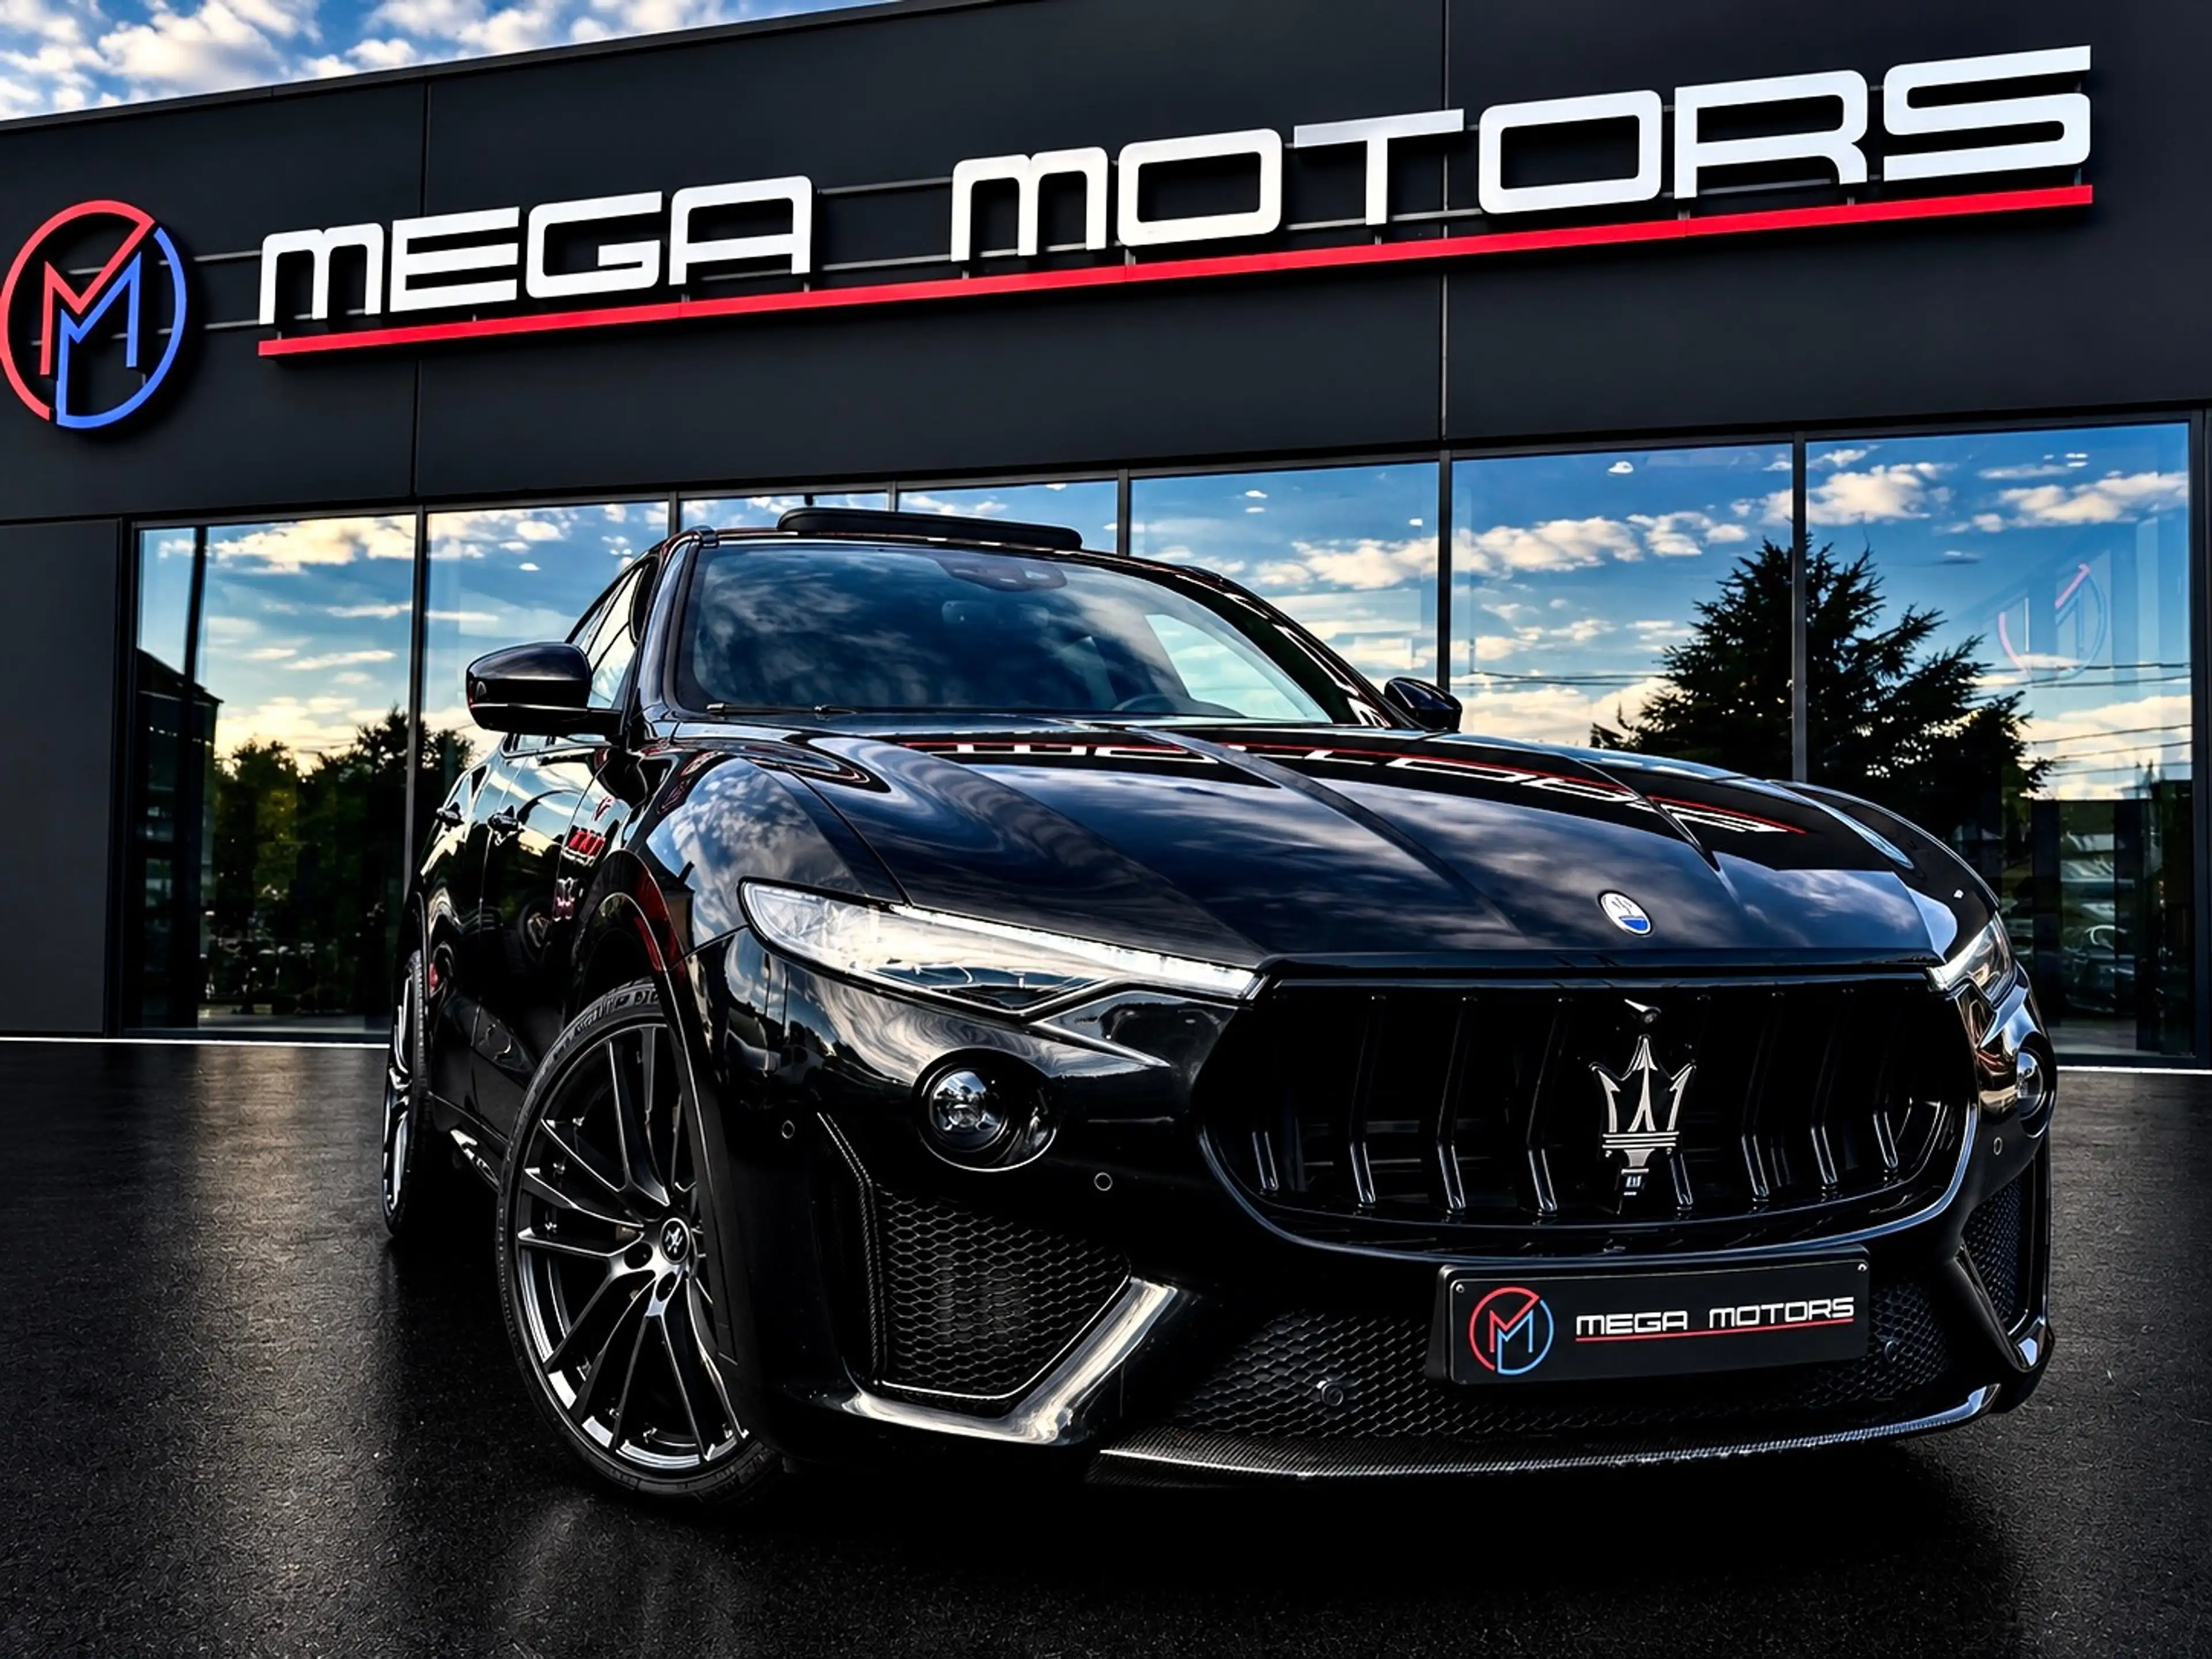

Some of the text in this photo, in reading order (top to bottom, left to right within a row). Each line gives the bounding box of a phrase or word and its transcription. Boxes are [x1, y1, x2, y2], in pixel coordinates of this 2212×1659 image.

[259, 46, 2092, 325] MEGA MOTORS
[1575, 1297, 1854, 1335] MEGA MOTORS
